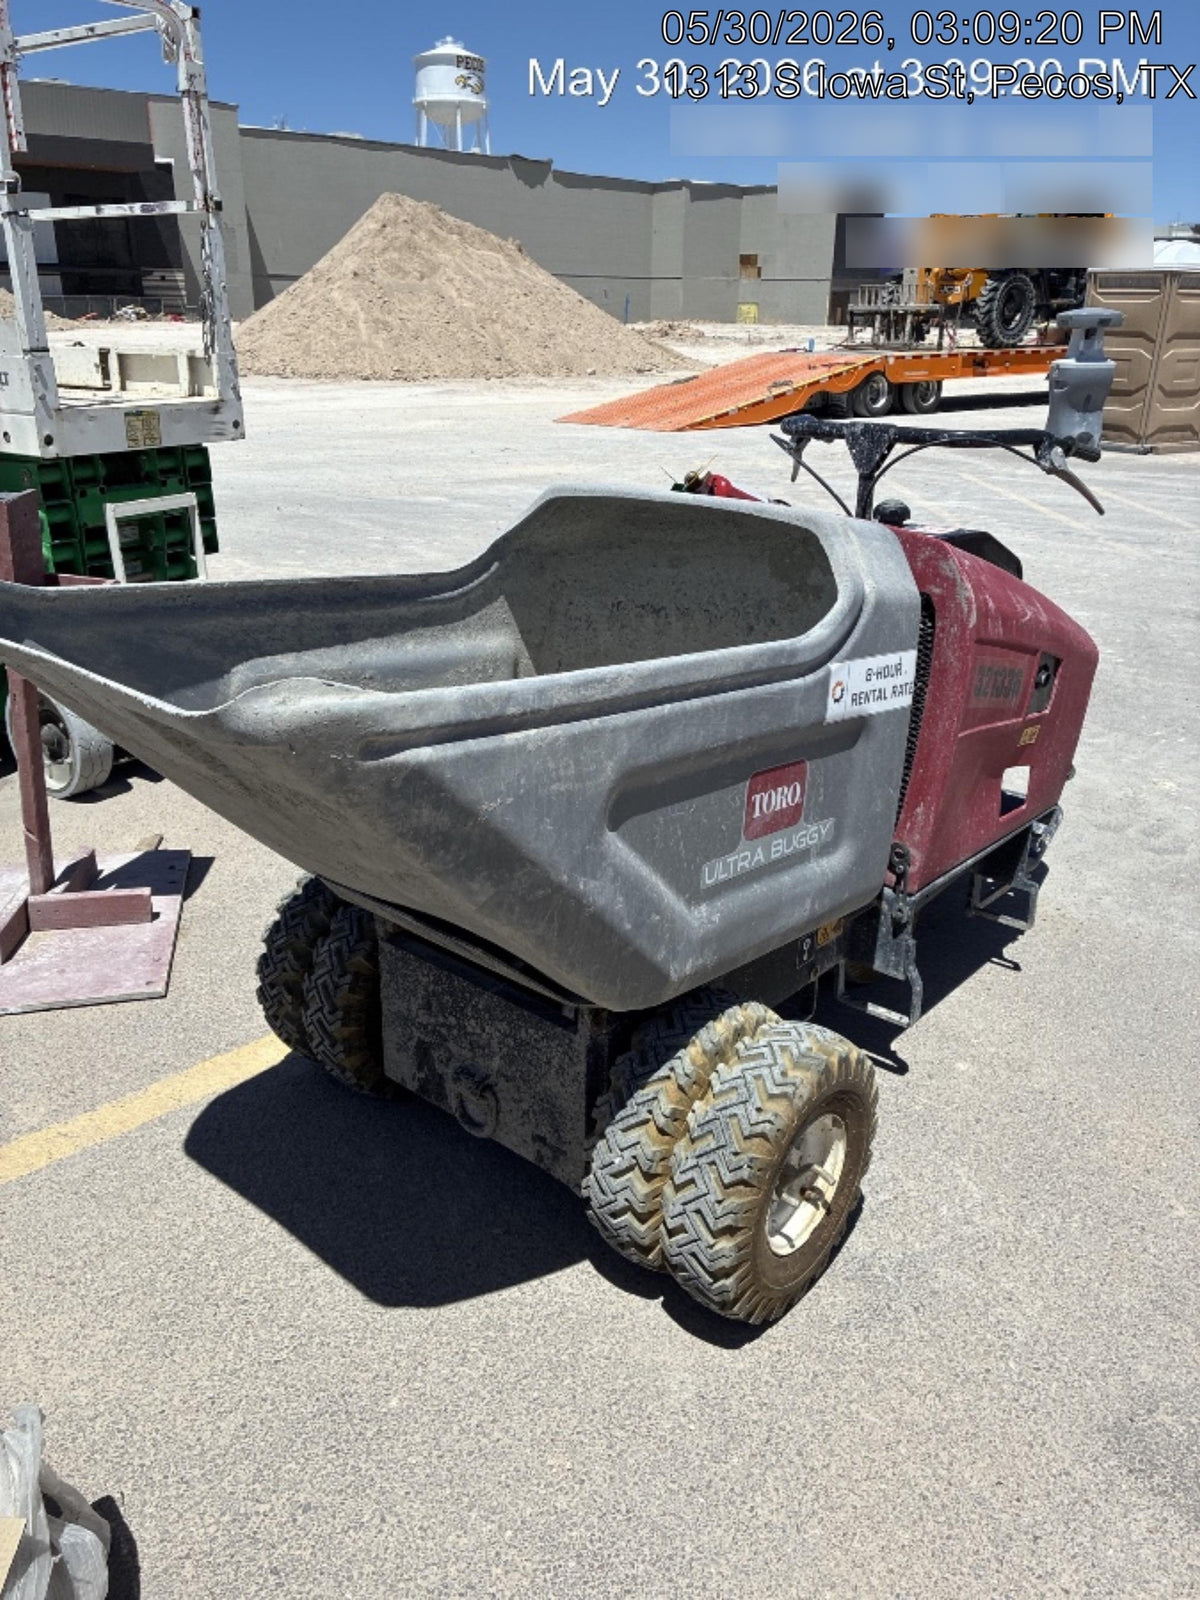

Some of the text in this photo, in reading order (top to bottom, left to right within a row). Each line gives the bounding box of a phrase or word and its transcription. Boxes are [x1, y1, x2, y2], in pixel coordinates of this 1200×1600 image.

[851, 688, 888, 707] RENTAL
[751, 781, 801, 819] TORO
[704, 822, 831, 885] ULTRA BUGGY
